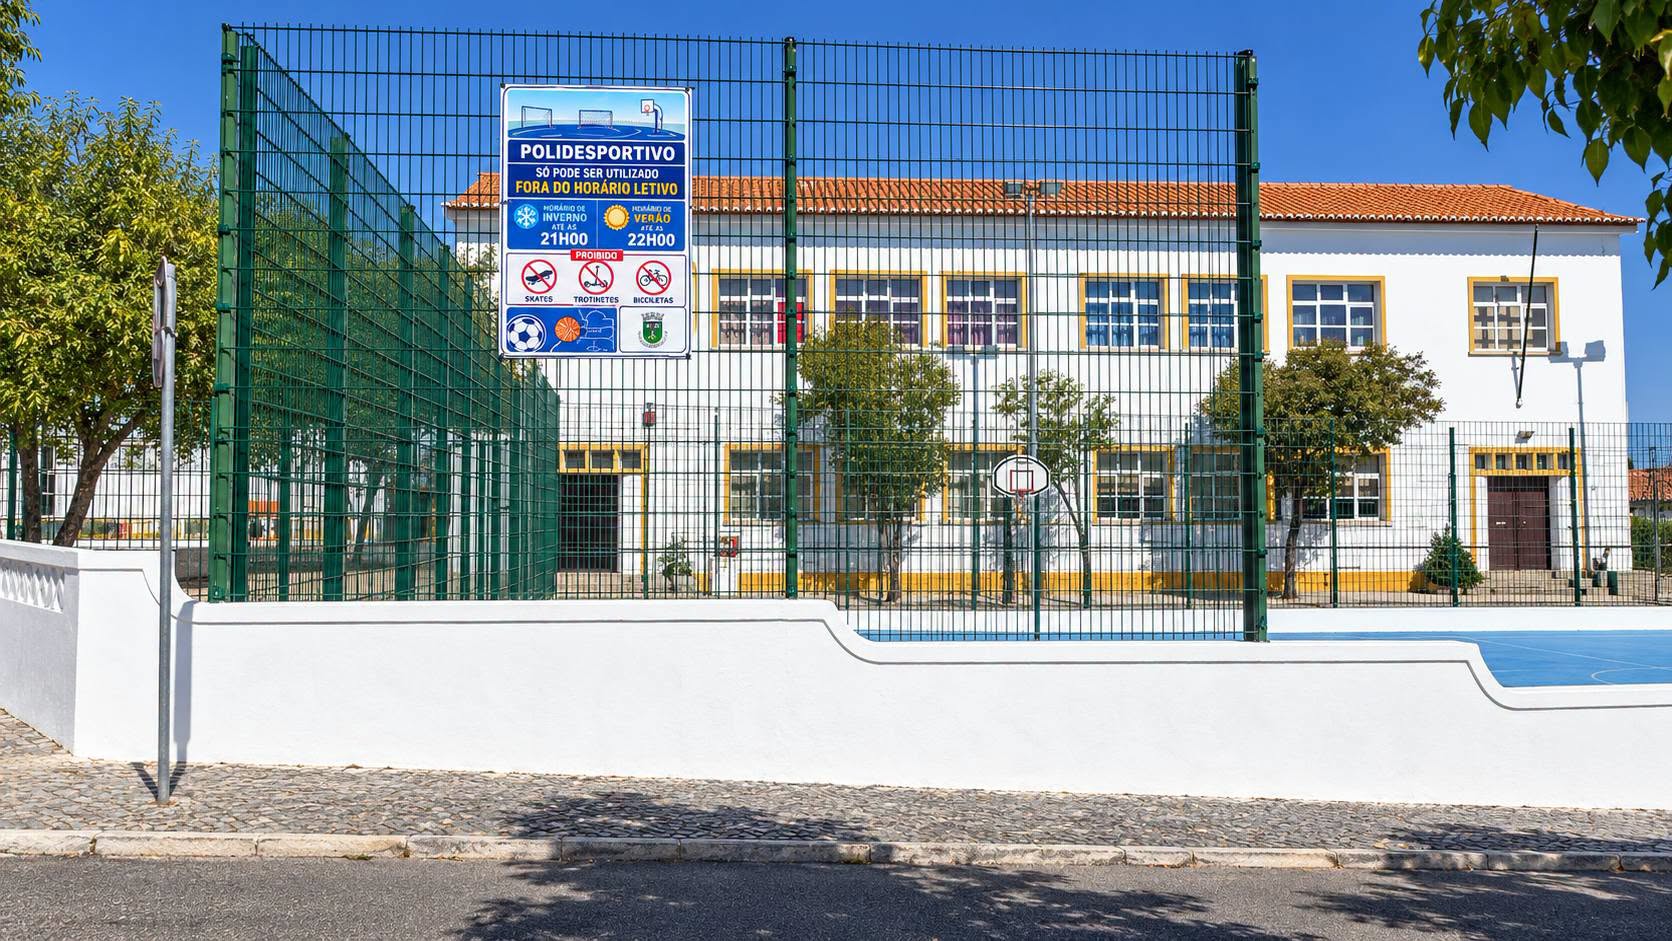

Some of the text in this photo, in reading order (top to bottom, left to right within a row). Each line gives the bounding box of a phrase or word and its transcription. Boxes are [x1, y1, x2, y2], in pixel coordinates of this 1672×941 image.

[520, 143, 675, 161] POLIDESPORTIVO
[535, 166, 659, 180] SÓ PODE SER UTILIZADO
[515, 178, 678, 196] FORA DO HORÁRIO LETIVO
[542, 212, 588, 222] INVERNO
[540, 231, 589, 246] 21H00
[627, 232, 676, 247] 22H00
[575, 250, 618, 260] PROIBIDO
[524, 295, 554, 303] SKATES
